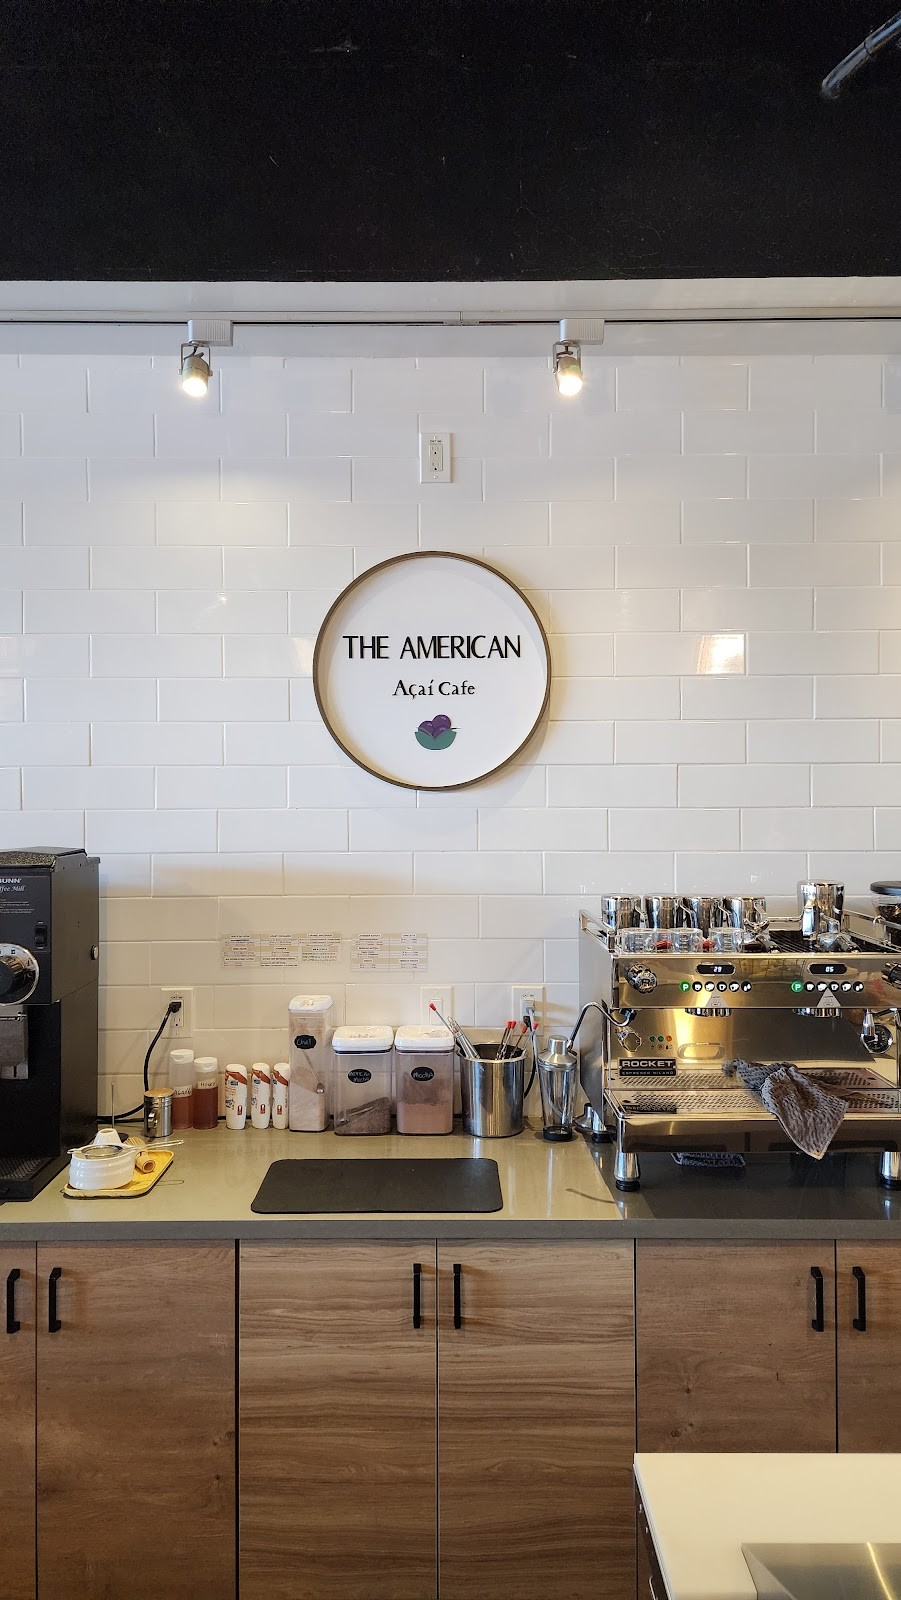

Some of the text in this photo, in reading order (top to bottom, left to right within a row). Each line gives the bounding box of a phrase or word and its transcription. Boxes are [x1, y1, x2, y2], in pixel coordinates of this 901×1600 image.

[343, 635, 521, 659] THE AMERICAN
[392, 679, 476, 700] Açaí Cafe
[621, 1060, 674, 1068] ROCKET
